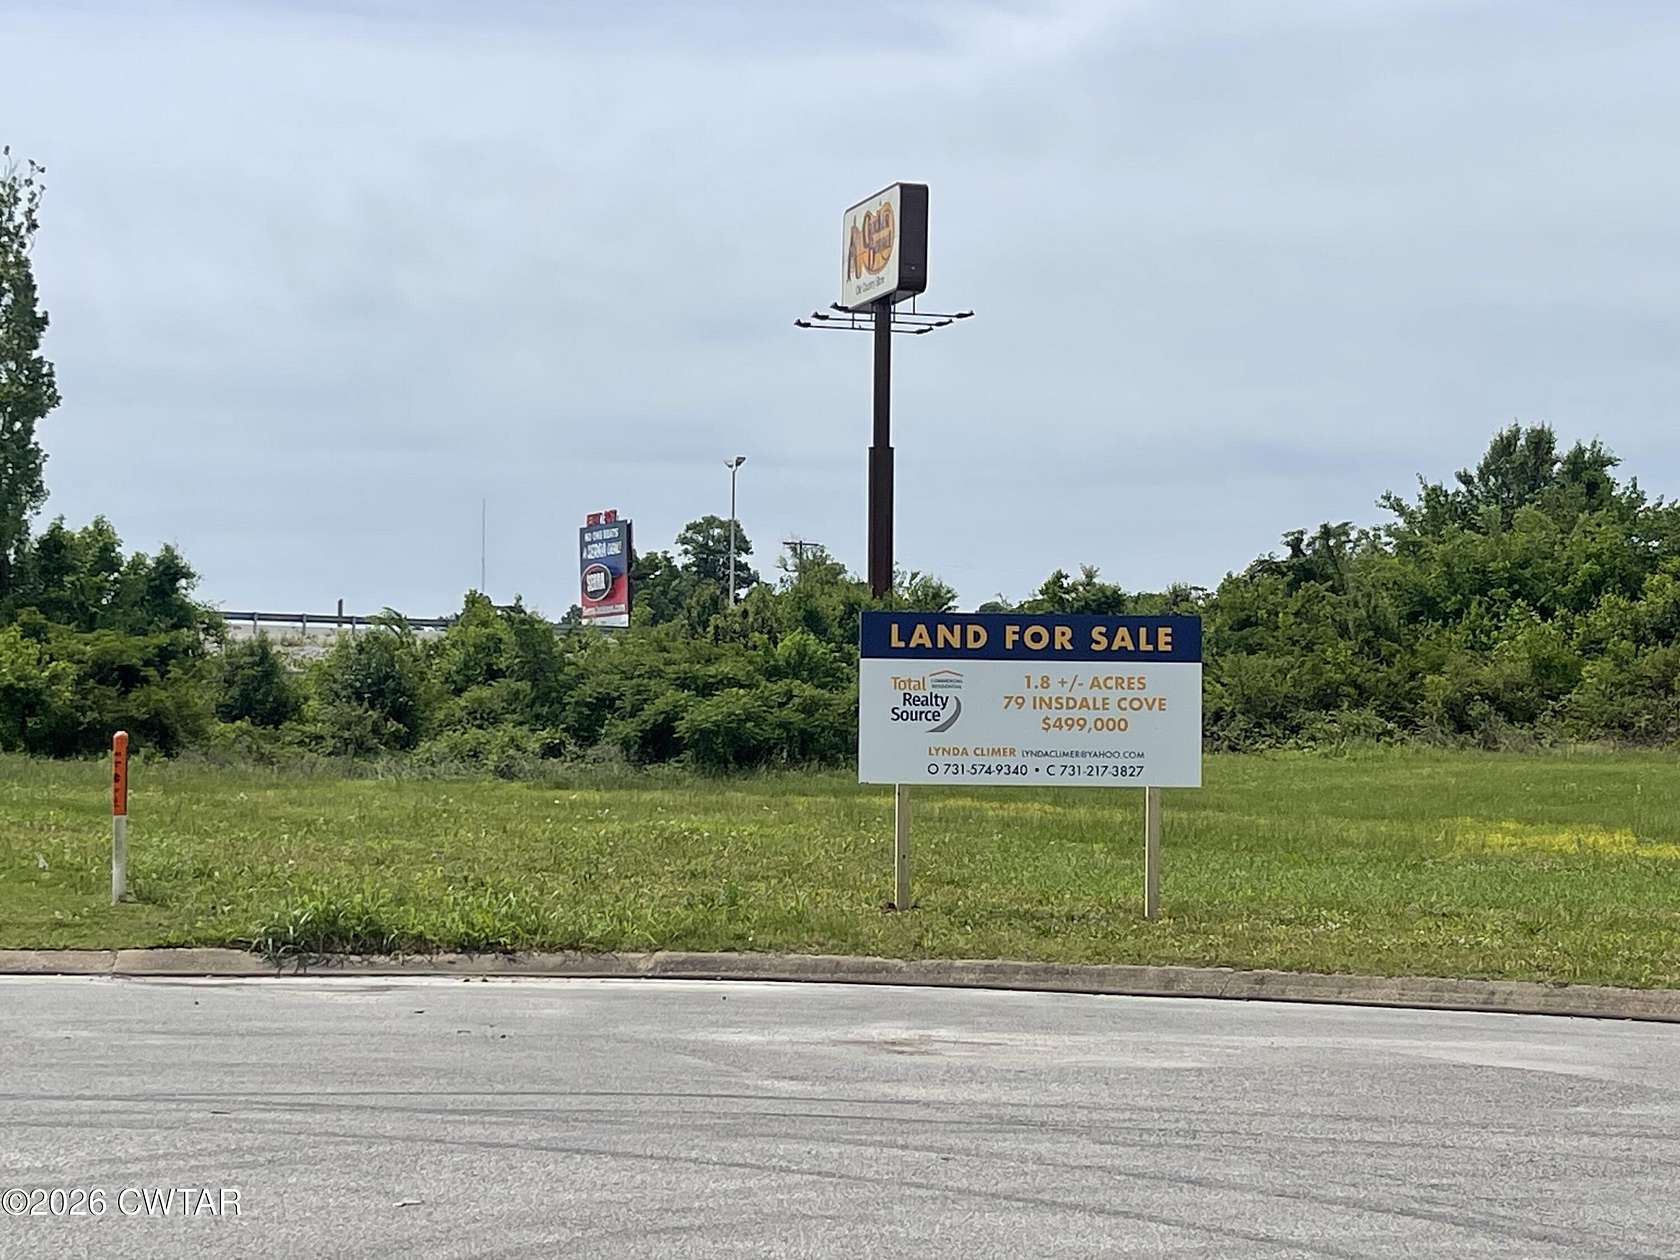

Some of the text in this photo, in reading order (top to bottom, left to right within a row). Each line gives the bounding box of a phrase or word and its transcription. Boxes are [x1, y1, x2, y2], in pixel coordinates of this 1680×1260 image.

[890, 623, 1173, 651] LAND FOR SALE
[891, 676, 927, 691] Total
[1024, 675, 1147, 692] 1.8 +/- ACRES
[902, 691, 949, 710] Realty
[1003, 696, 1168, 711] 79 INSDALE COVE
[890, 707, 941, 722] Source
[1041, 716, 1129, 733] $499,000
[928, 747, 969, 757] LYNDA
[973, 747, 1017, 758] CLIMER
[928, 763, 1145, 777] O 731-574-9340 C 731-217-3827
